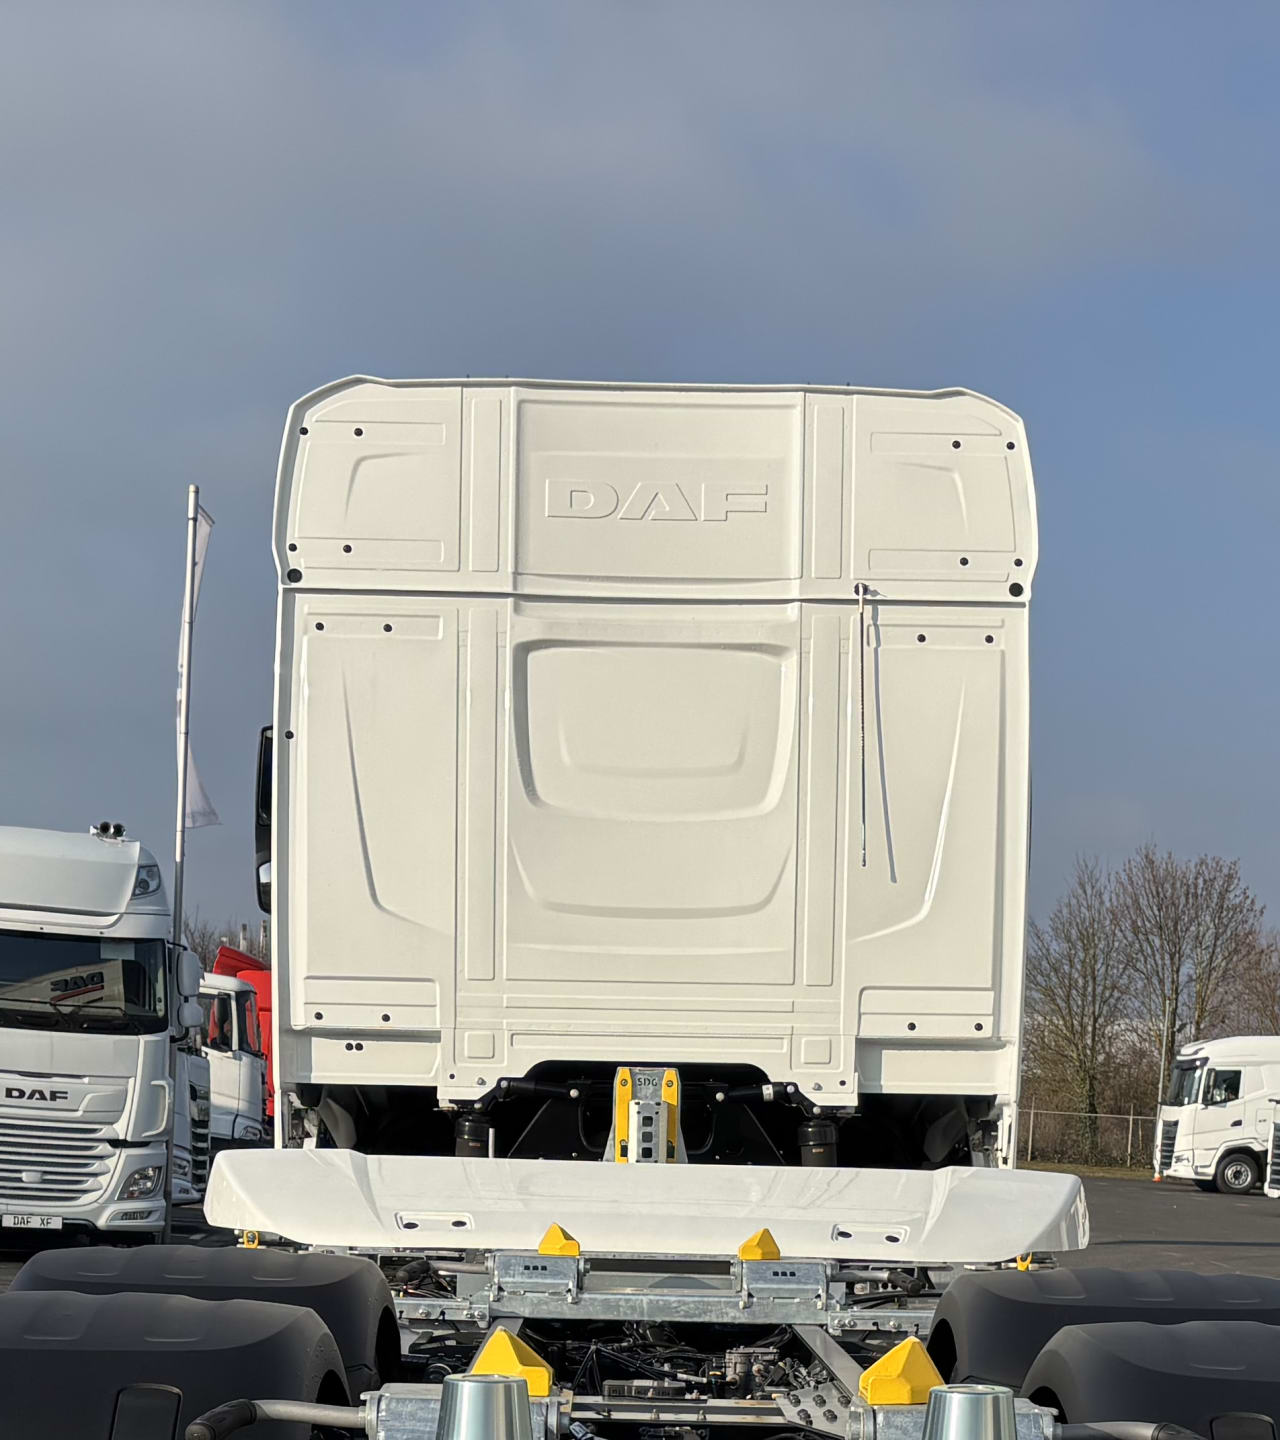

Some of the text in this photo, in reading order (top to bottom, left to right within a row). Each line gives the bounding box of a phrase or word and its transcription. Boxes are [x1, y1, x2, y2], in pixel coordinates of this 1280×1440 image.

[545, 479, 769, 522] DAF
[637, 1077, 658, 1087] SDG
[4, 1087, 69, 1102] DAF
[13, 1215, 53, 1227] DAF XF
